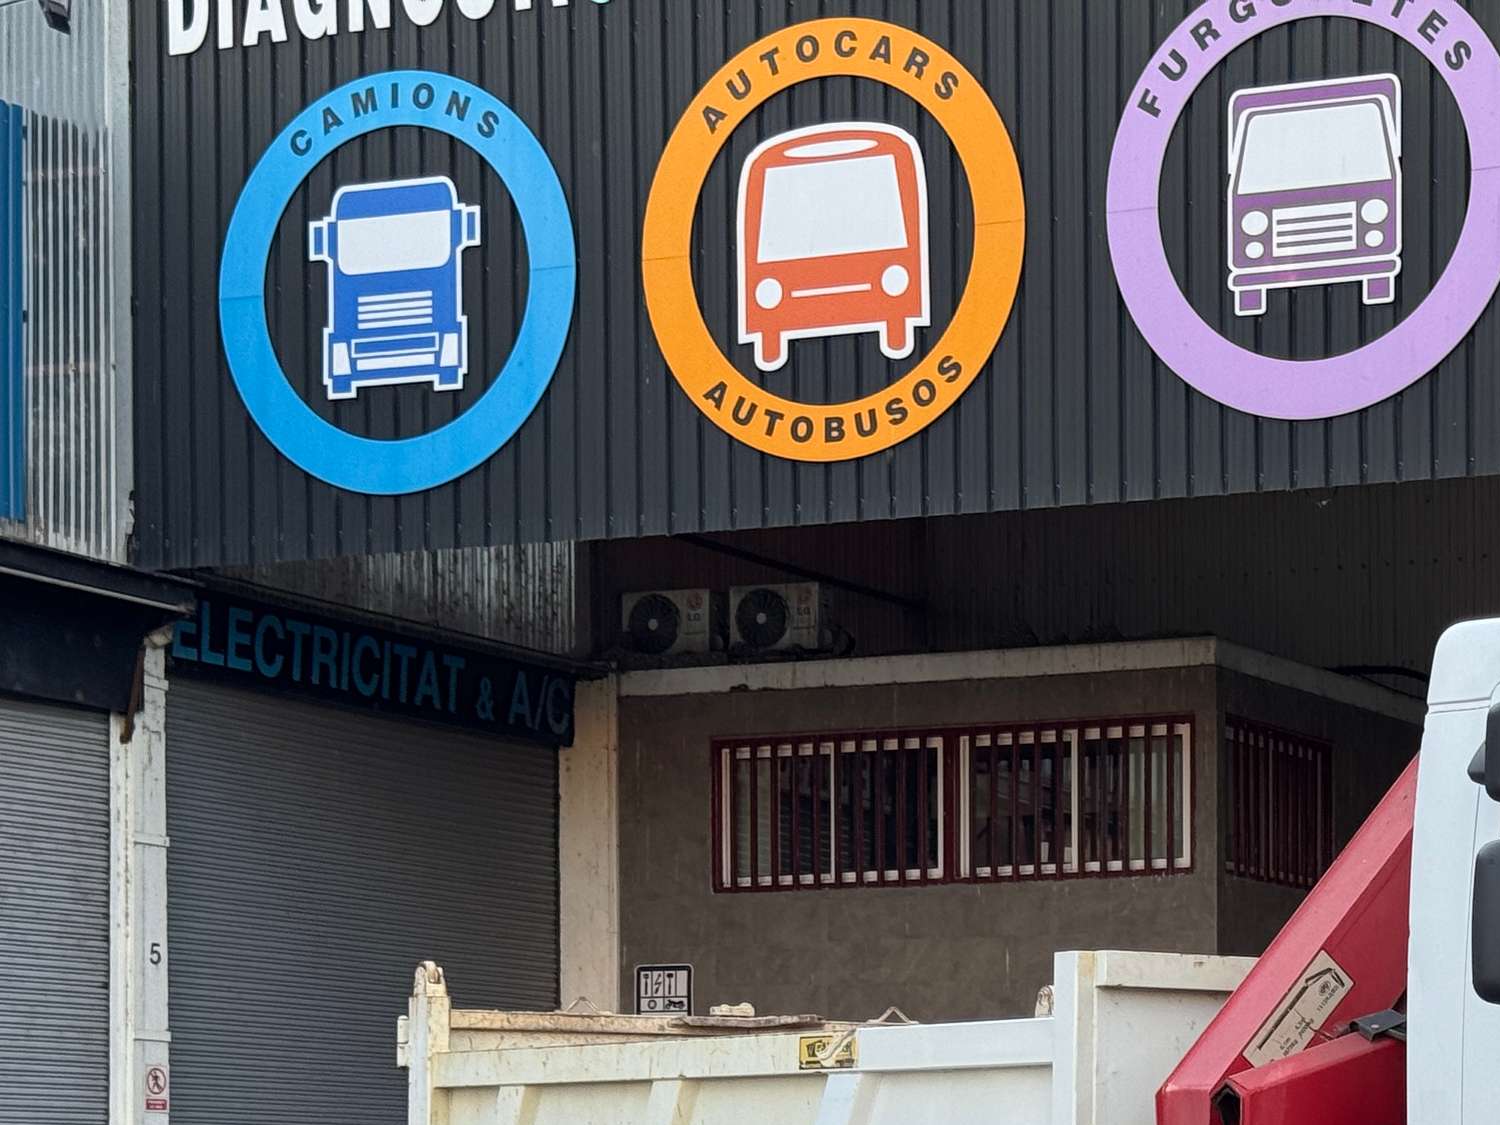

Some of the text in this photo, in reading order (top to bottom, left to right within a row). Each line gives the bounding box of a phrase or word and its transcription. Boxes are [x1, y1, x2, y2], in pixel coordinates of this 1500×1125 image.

[290, 82, 500, 157] CAMIONS
[701, 30, 959, 135] AUTOCARS
[703, 355, 962, 443] AUTOBUSOS
[172, 601, 571, 736] ELECTRICITAT & A/C
[150, 942, 161, 965] 5
